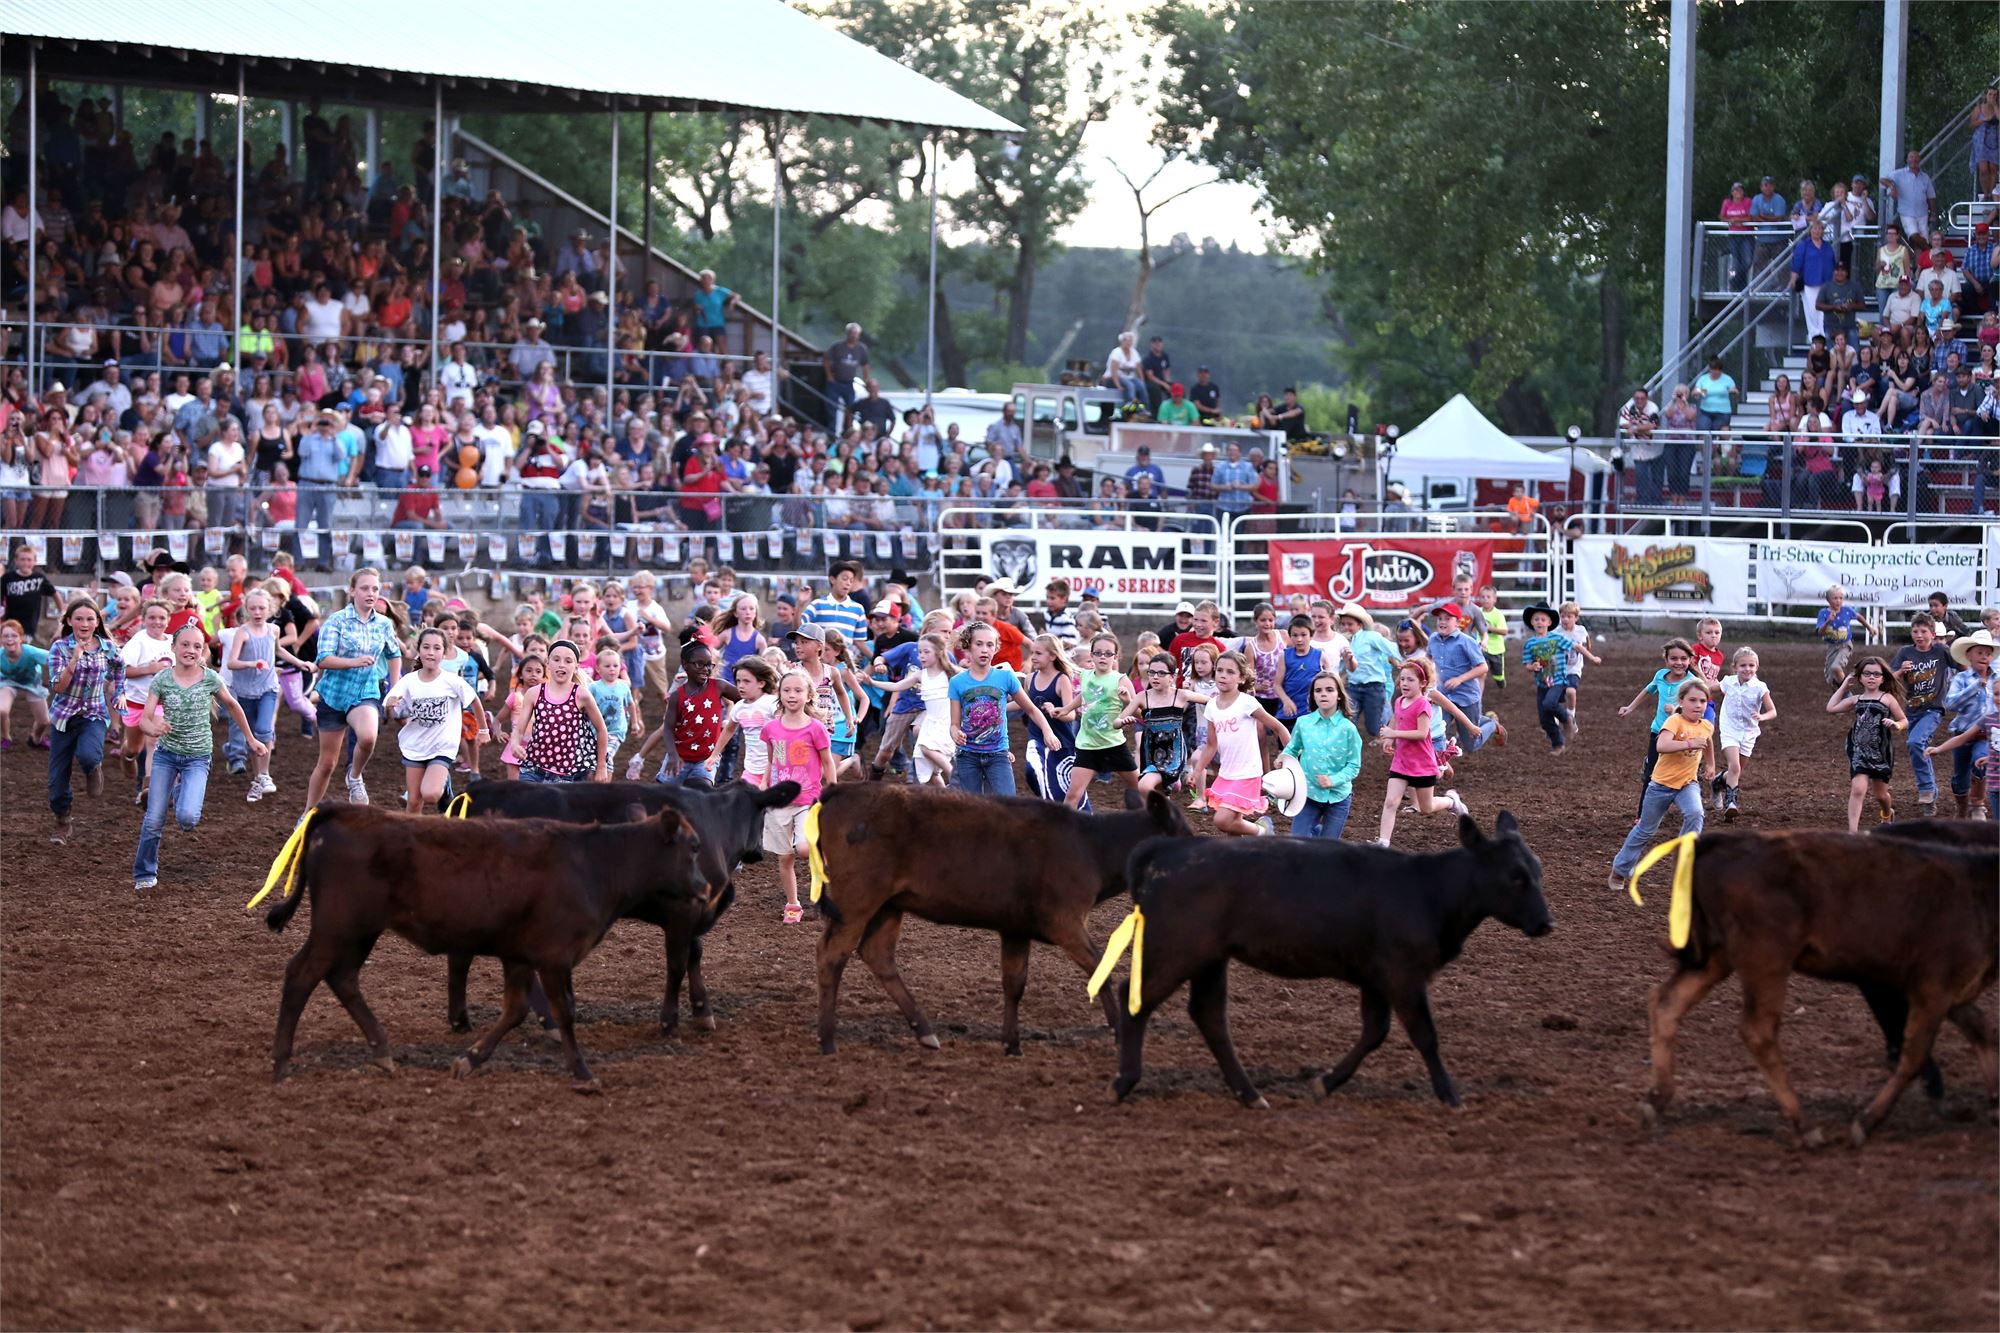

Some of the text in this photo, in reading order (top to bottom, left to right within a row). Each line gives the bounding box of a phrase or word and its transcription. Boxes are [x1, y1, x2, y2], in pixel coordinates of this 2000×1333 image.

[1049, 544, 1176, 570] RAM
[1760, 545, 1976, 569] Tri-State Chiropractic Center
[1331, 546, 1424, 602] Justin
[1841, 573, 1944, 591] Dr. Doug Larson
[1051, 576, 1176, 593] DEO SERIES
[1904, 593, 1927, 604] Belle
[1215, 716, 1240, 734] ove
